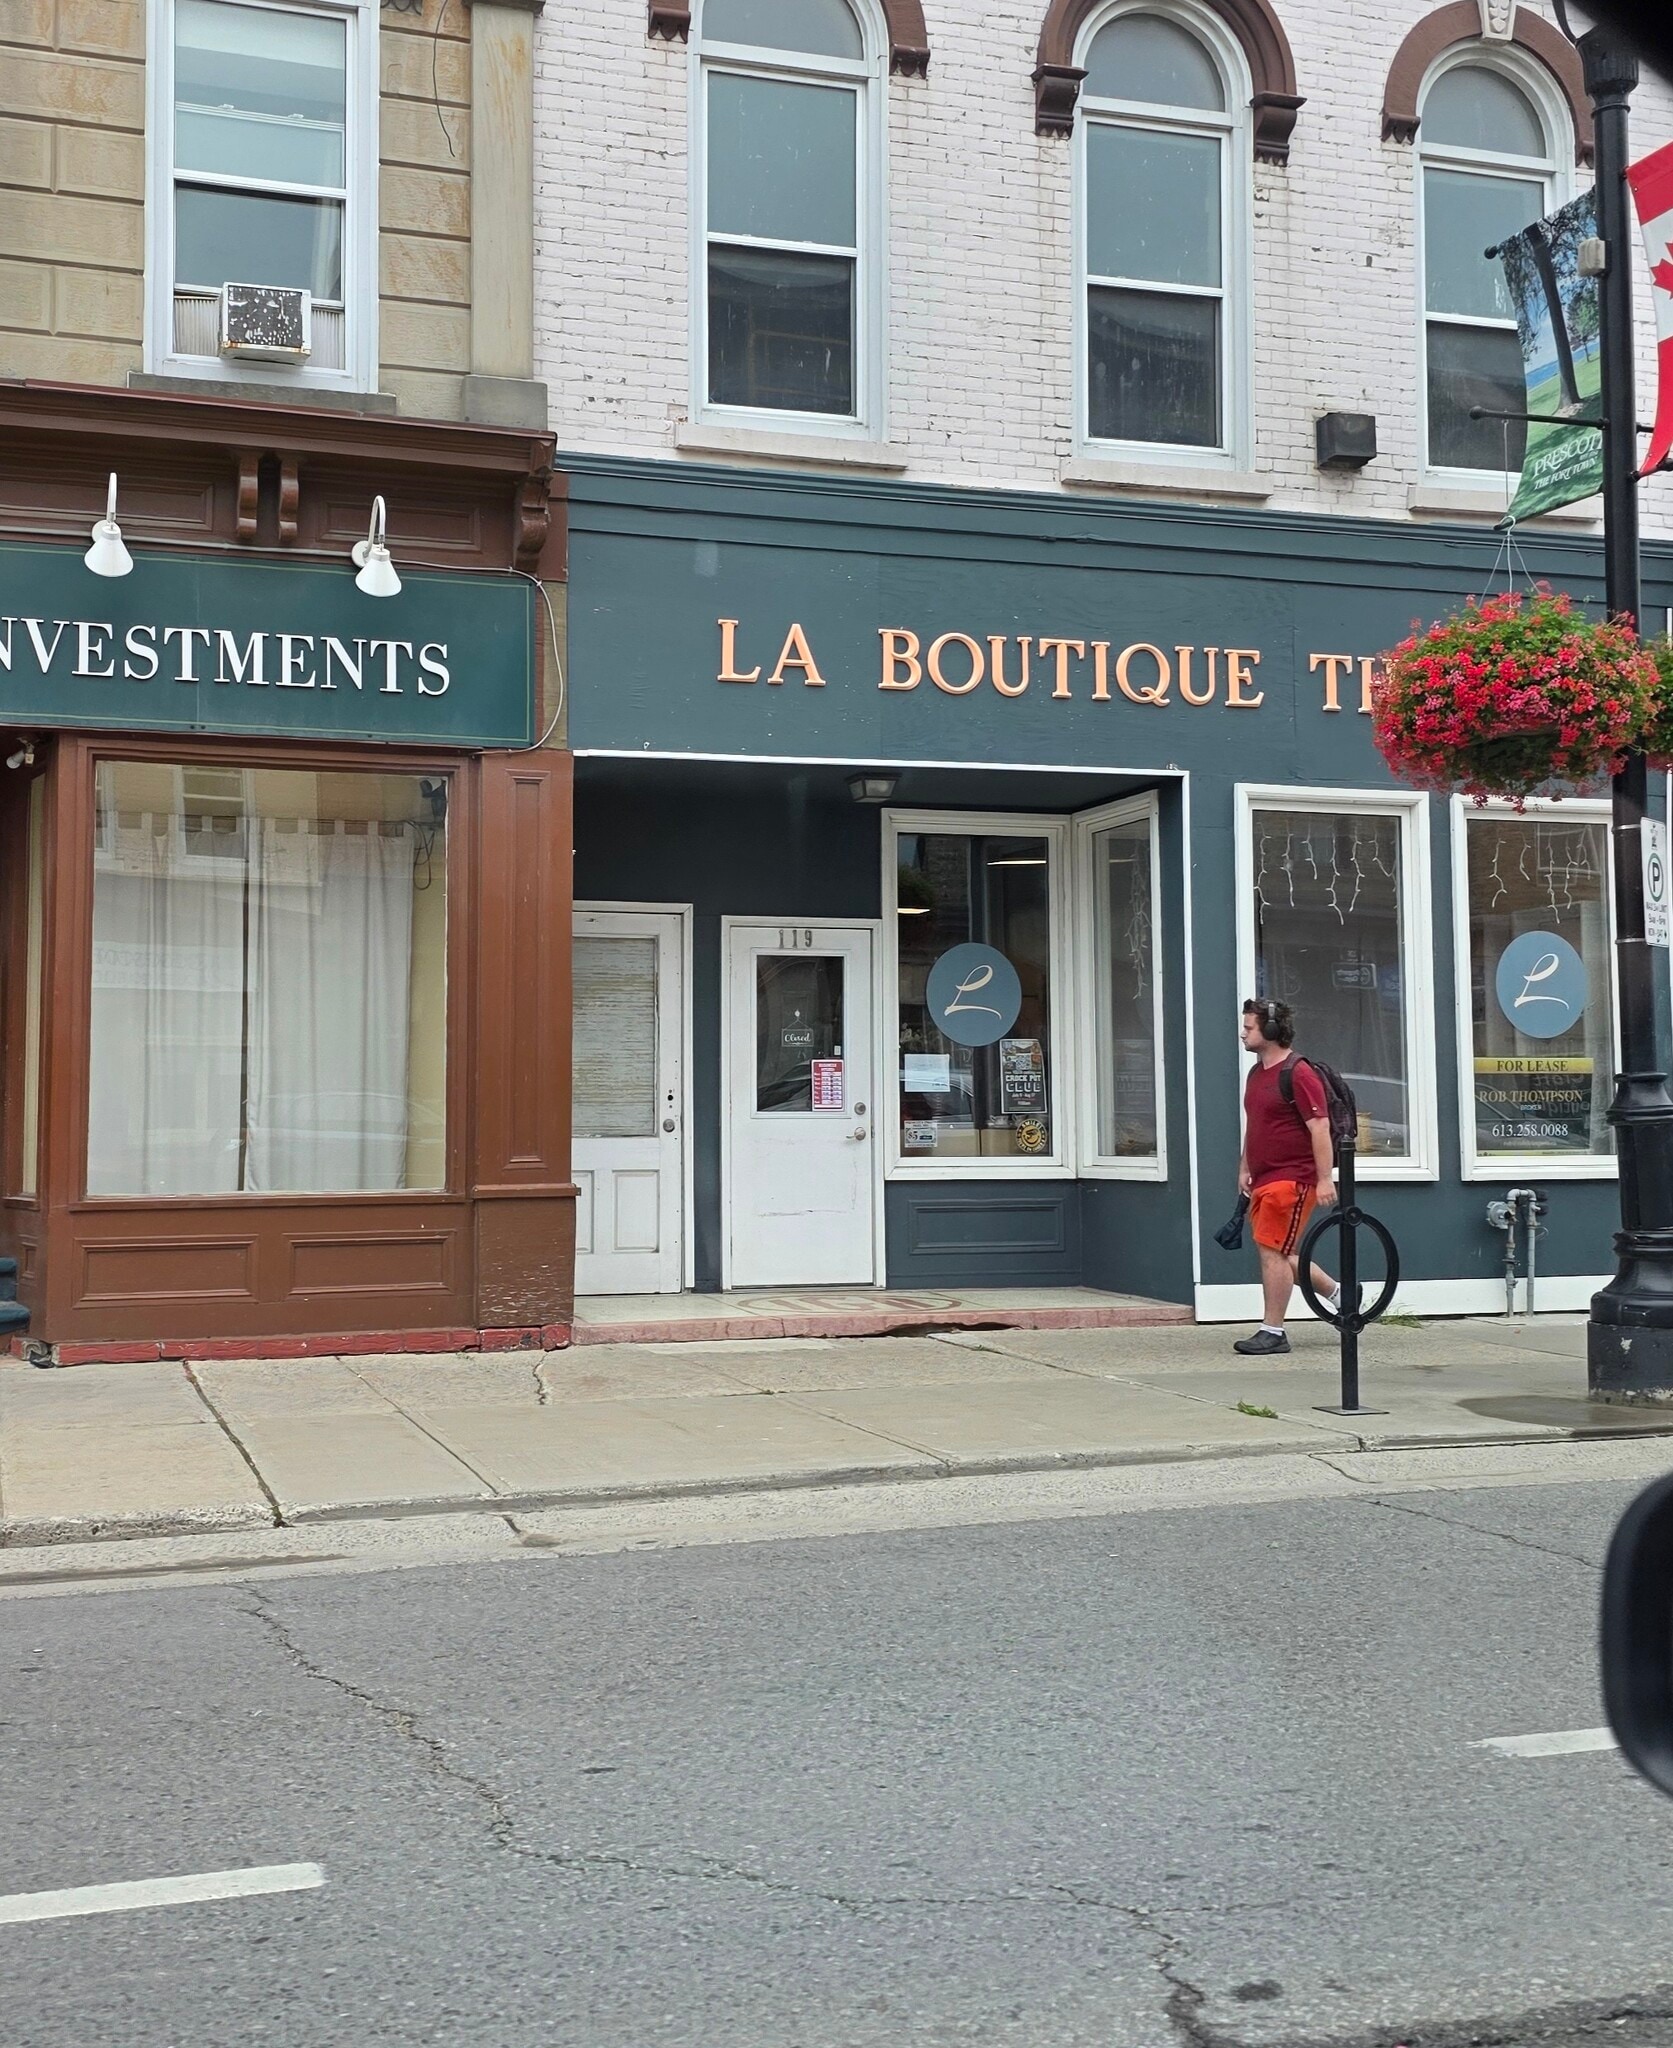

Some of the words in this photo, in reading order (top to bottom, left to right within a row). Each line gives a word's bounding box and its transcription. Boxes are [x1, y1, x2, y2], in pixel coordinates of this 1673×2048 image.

[1532, 433, 1603, 480] PRESCOTT
[1534, 474, 1551, 490] THE
[1551, 466, 1571, 481] FORT
[717, 618, 826, 687] LA
[877, 628, 1265, 708] BOUTIQUE
[778, 929, 813, 949] 119
[943, 964, 1002, 1020] L
[1514, 953, 1570, 1010] L
[784, 1033, 812, 1043] Closed
[1497, 1060, 1524, 1072] FOR
[1527, 1060, 1568, 1072] LEASE
[1479, 1090, 1507, 1103] ROB
[1509, 1090, 1583, 1103] THOMPSON
[1492, 1124, 1569, 1137] 613.258.0088
